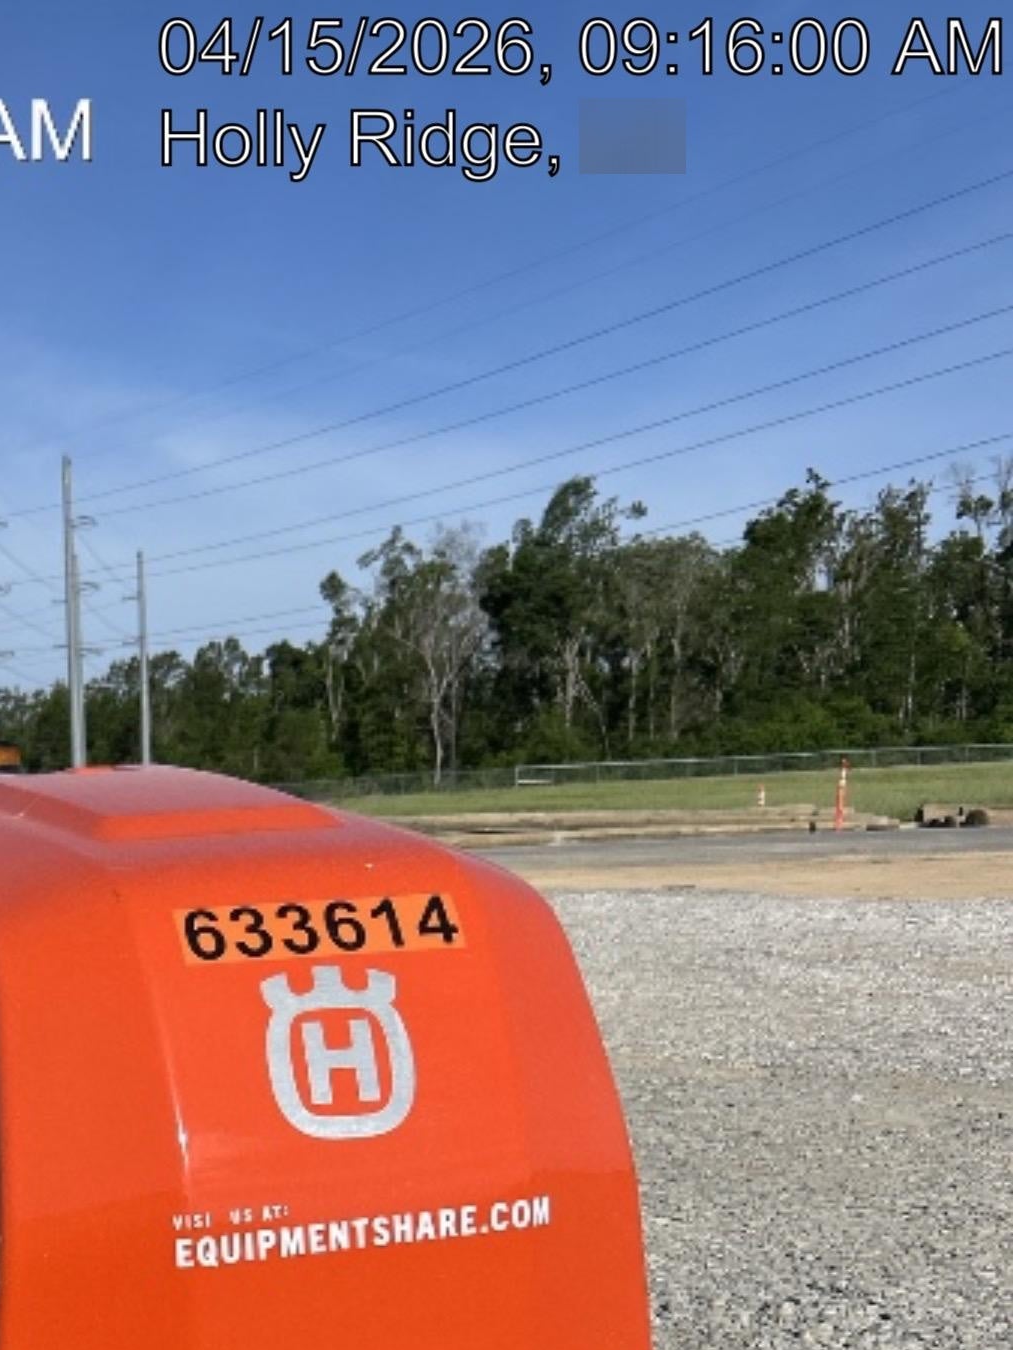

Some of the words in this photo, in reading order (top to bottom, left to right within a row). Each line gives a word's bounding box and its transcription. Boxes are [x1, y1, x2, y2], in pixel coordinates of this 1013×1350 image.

[184, 895, 459, 961] 633614
[172, 1211, 212, 1231] VISI
[174, 1196, 551, 1269] EQUIPMENTSHARE.COM
